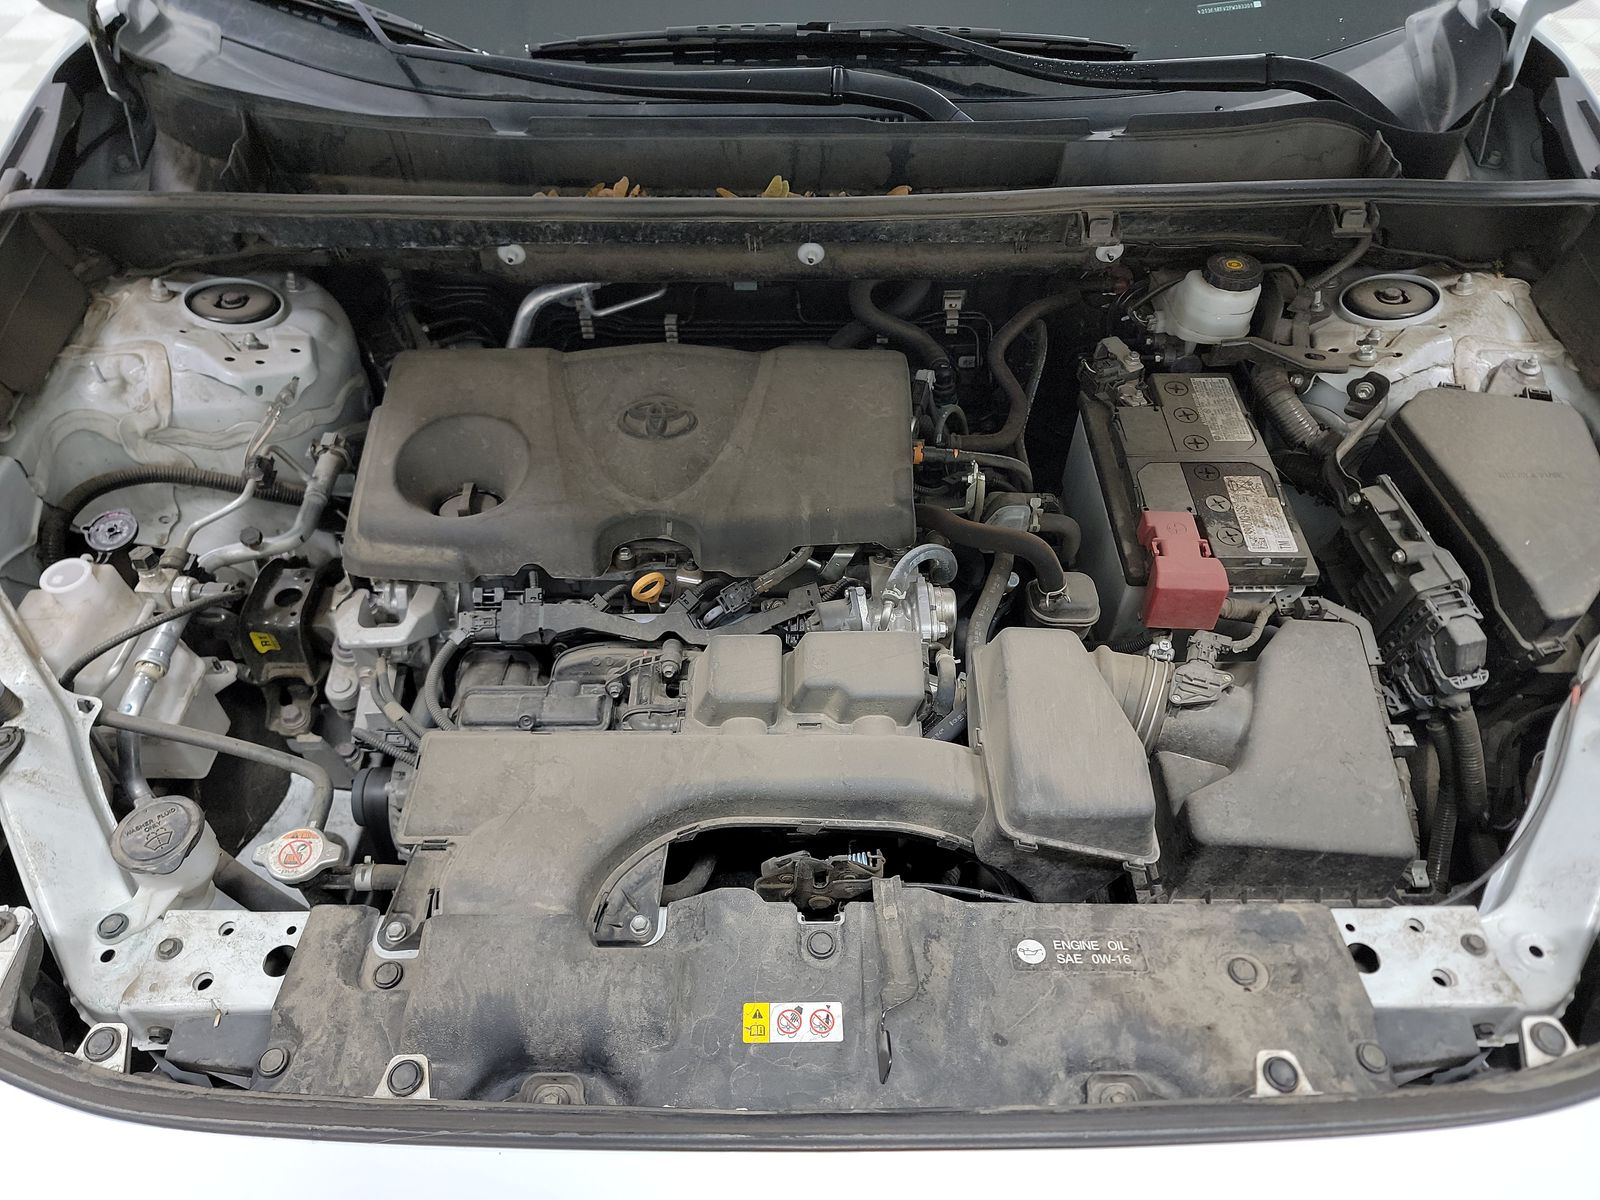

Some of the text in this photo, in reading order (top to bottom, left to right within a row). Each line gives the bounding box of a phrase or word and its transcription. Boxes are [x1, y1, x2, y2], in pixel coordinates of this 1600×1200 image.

[125, 807, 176, 836] WASHER FLUID
[144, 821, 161, 832] ONLY
[1052, 940, 1129, 951] ENGINE OIL
[1056, 953, 1132, 965] SAE 0W-16
